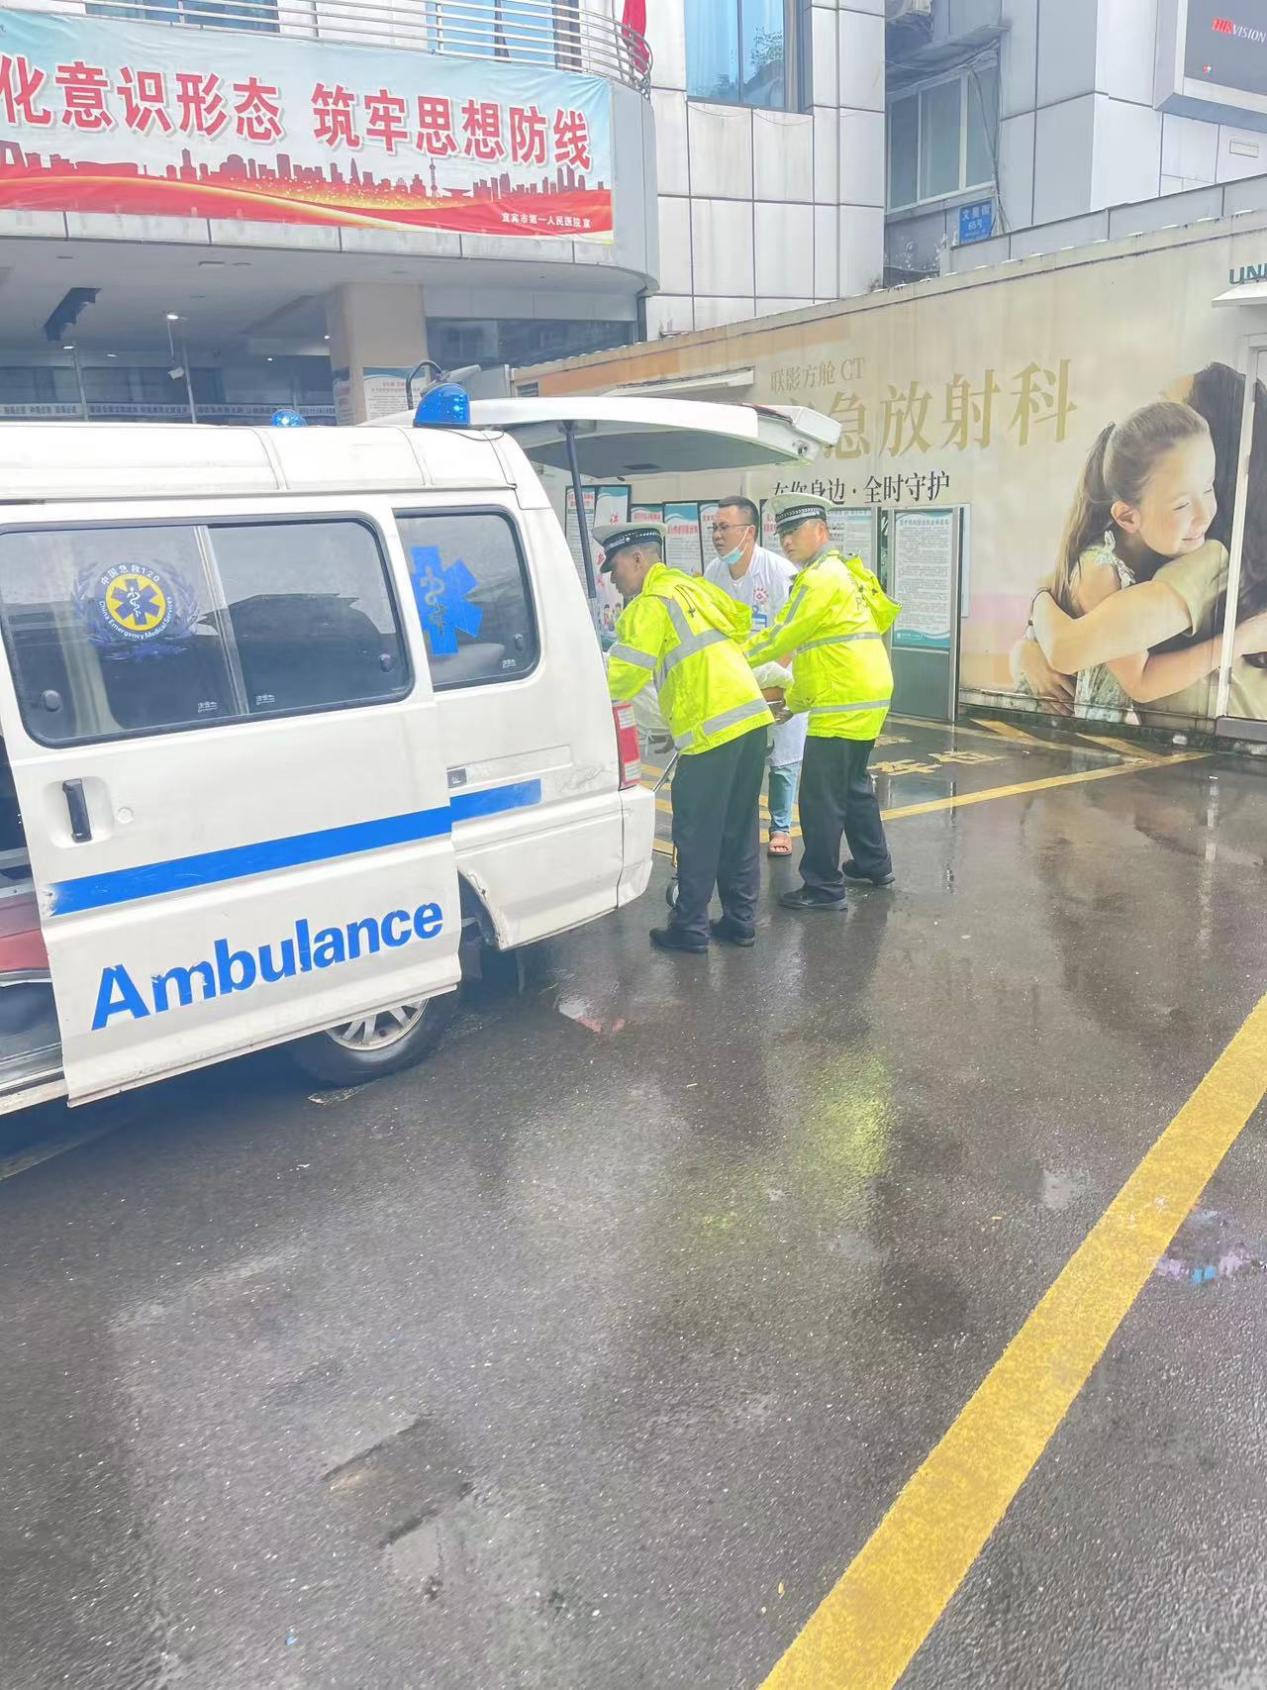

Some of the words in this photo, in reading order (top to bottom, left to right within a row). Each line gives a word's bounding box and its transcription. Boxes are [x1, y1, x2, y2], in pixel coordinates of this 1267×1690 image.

[1211, 17, 1267, 44] HIKVISION
[0, 55, 282, 141] 化意识形态
[310, 83, 592, 170] 筑牢思想防线
[789, 359, 1078, 460] 急放射科
[840, 356, 866, 381] CT
[91, 901, 443, 1031] Ambulance
